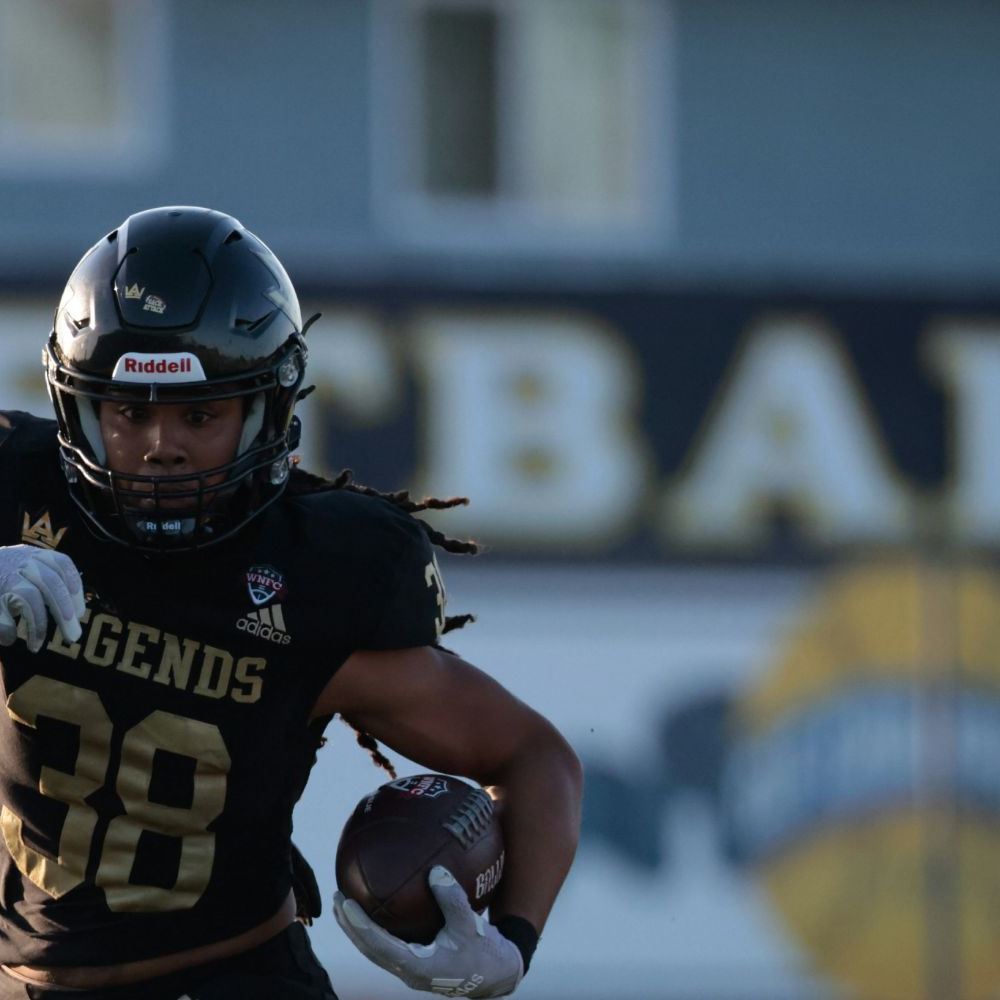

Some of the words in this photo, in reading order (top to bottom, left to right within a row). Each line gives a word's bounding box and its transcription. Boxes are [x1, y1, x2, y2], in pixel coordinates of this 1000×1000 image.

[124, 358, 192, 374] Riddell
[146, 521, 181, 531] Ridell
[247, 572, 283, 590] WNFC
[236, 617, 292, 646] adidas
[17, 607, 267, 704] EGENDS
[0, 674, 232, 913] 38
